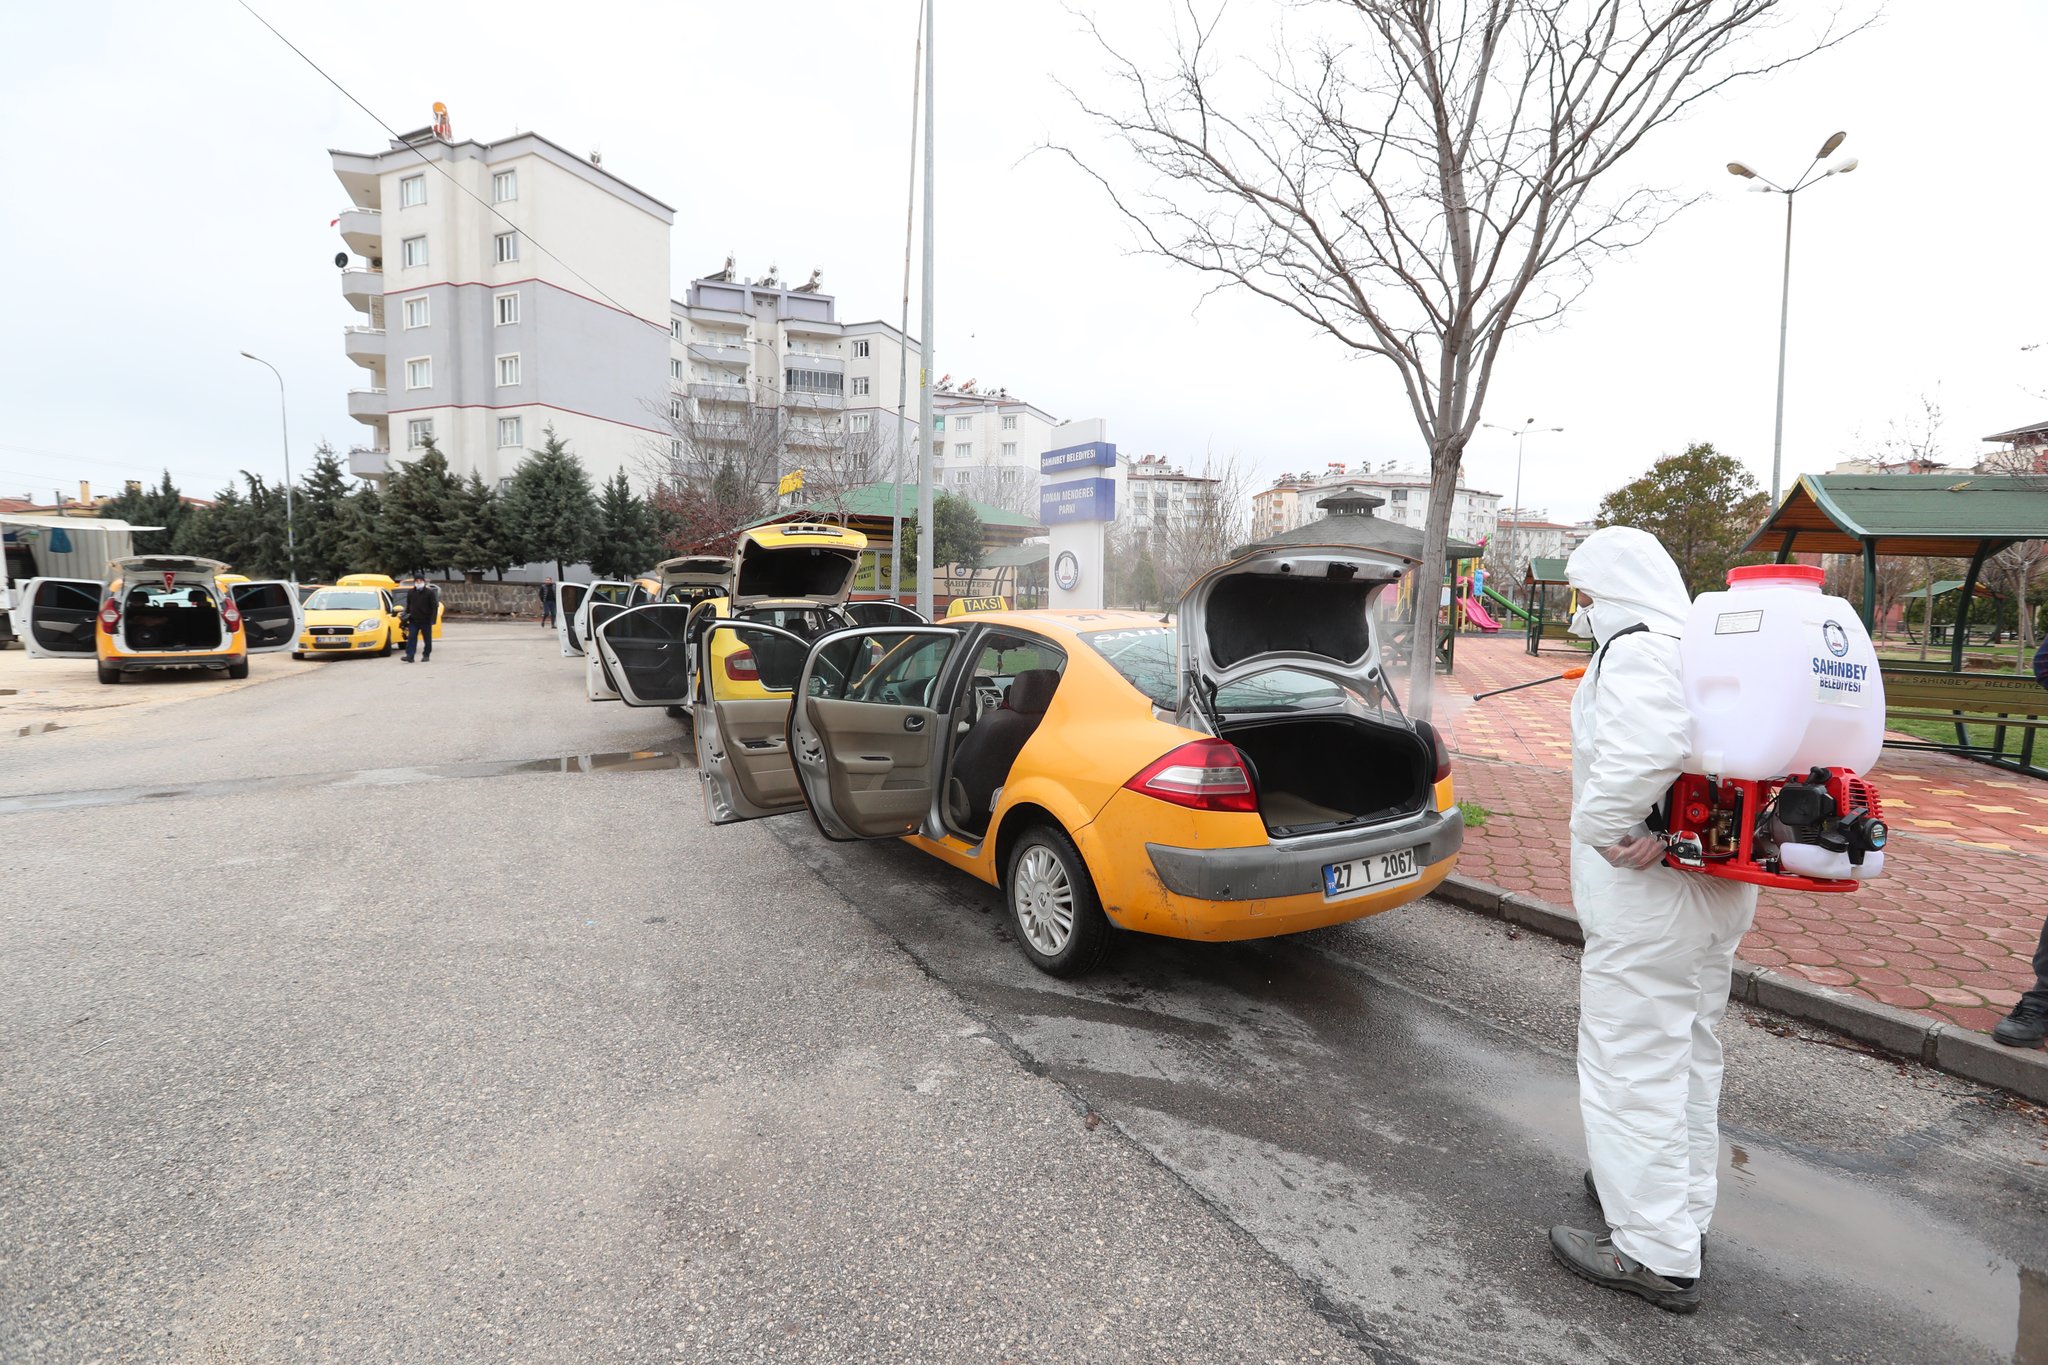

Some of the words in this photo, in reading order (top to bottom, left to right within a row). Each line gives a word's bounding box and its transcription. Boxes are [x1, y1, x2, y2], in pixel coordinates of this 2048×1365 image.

[1062, 487, 1094, 500] MENDERES
[964, 598, 1001, 610] TAKSİ
[1334, 864, 1351, 889] 27
[1362, 860, 1371, 882] T
[1381, 850, 1412, 878] 2067
